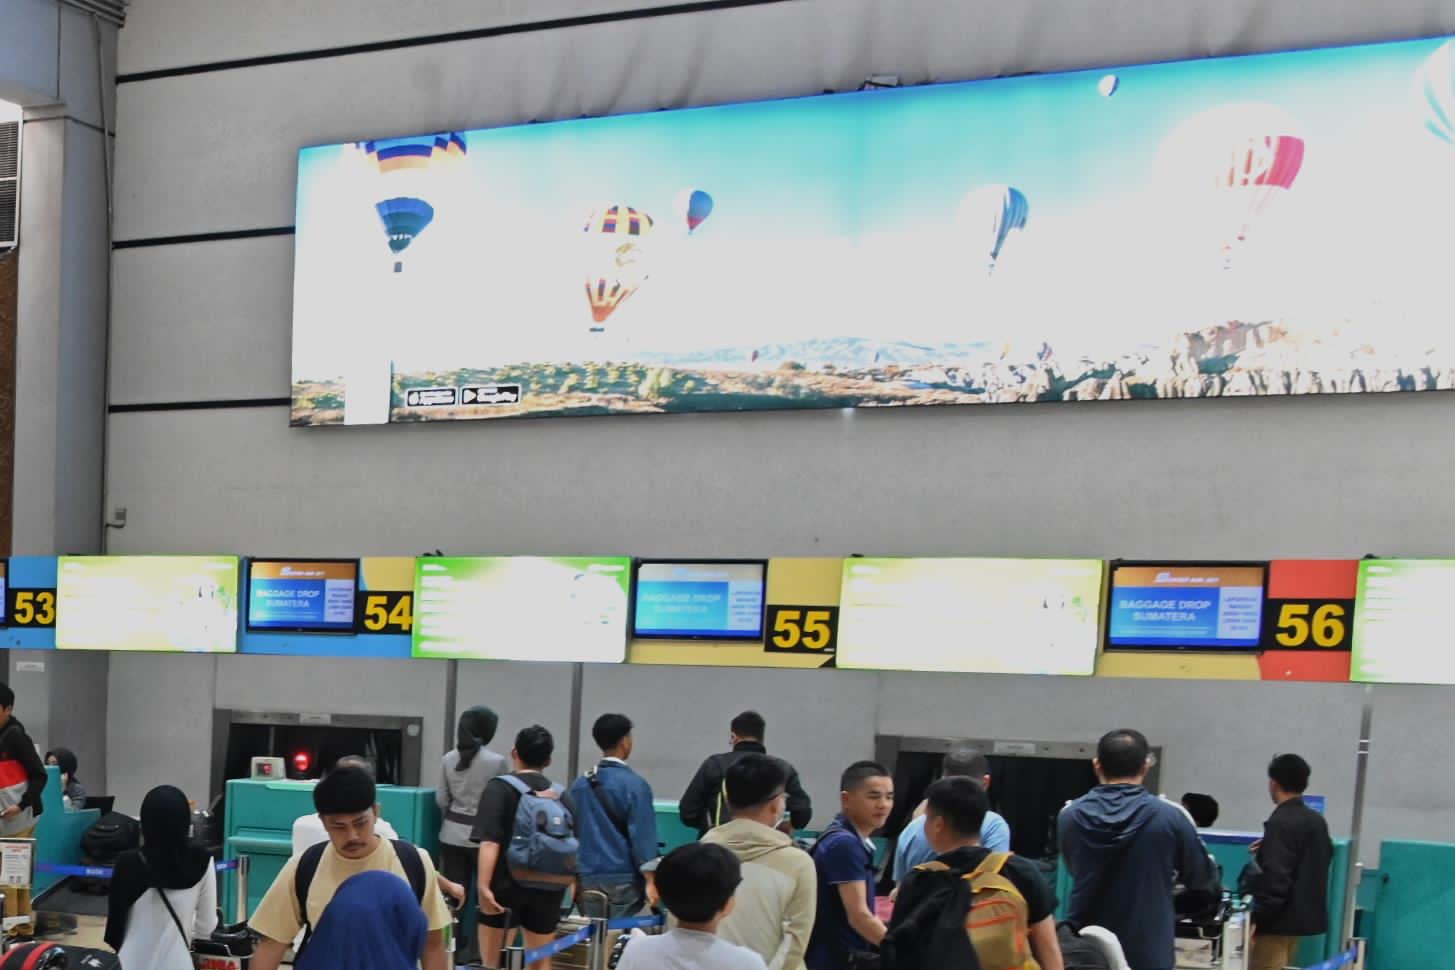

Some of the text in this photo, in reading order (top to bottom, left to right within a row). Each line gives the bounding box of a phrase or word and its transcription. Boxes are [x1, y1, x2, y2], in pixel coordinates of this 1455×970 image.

[14, 592, 55, 624] 53
[364, 595, 412, 631] 54
[1119, 600, 1212, 609] BAGGAGE DROP
[773, 610, 830, 648] 55
[1275, 604, 1345, 647] 56
